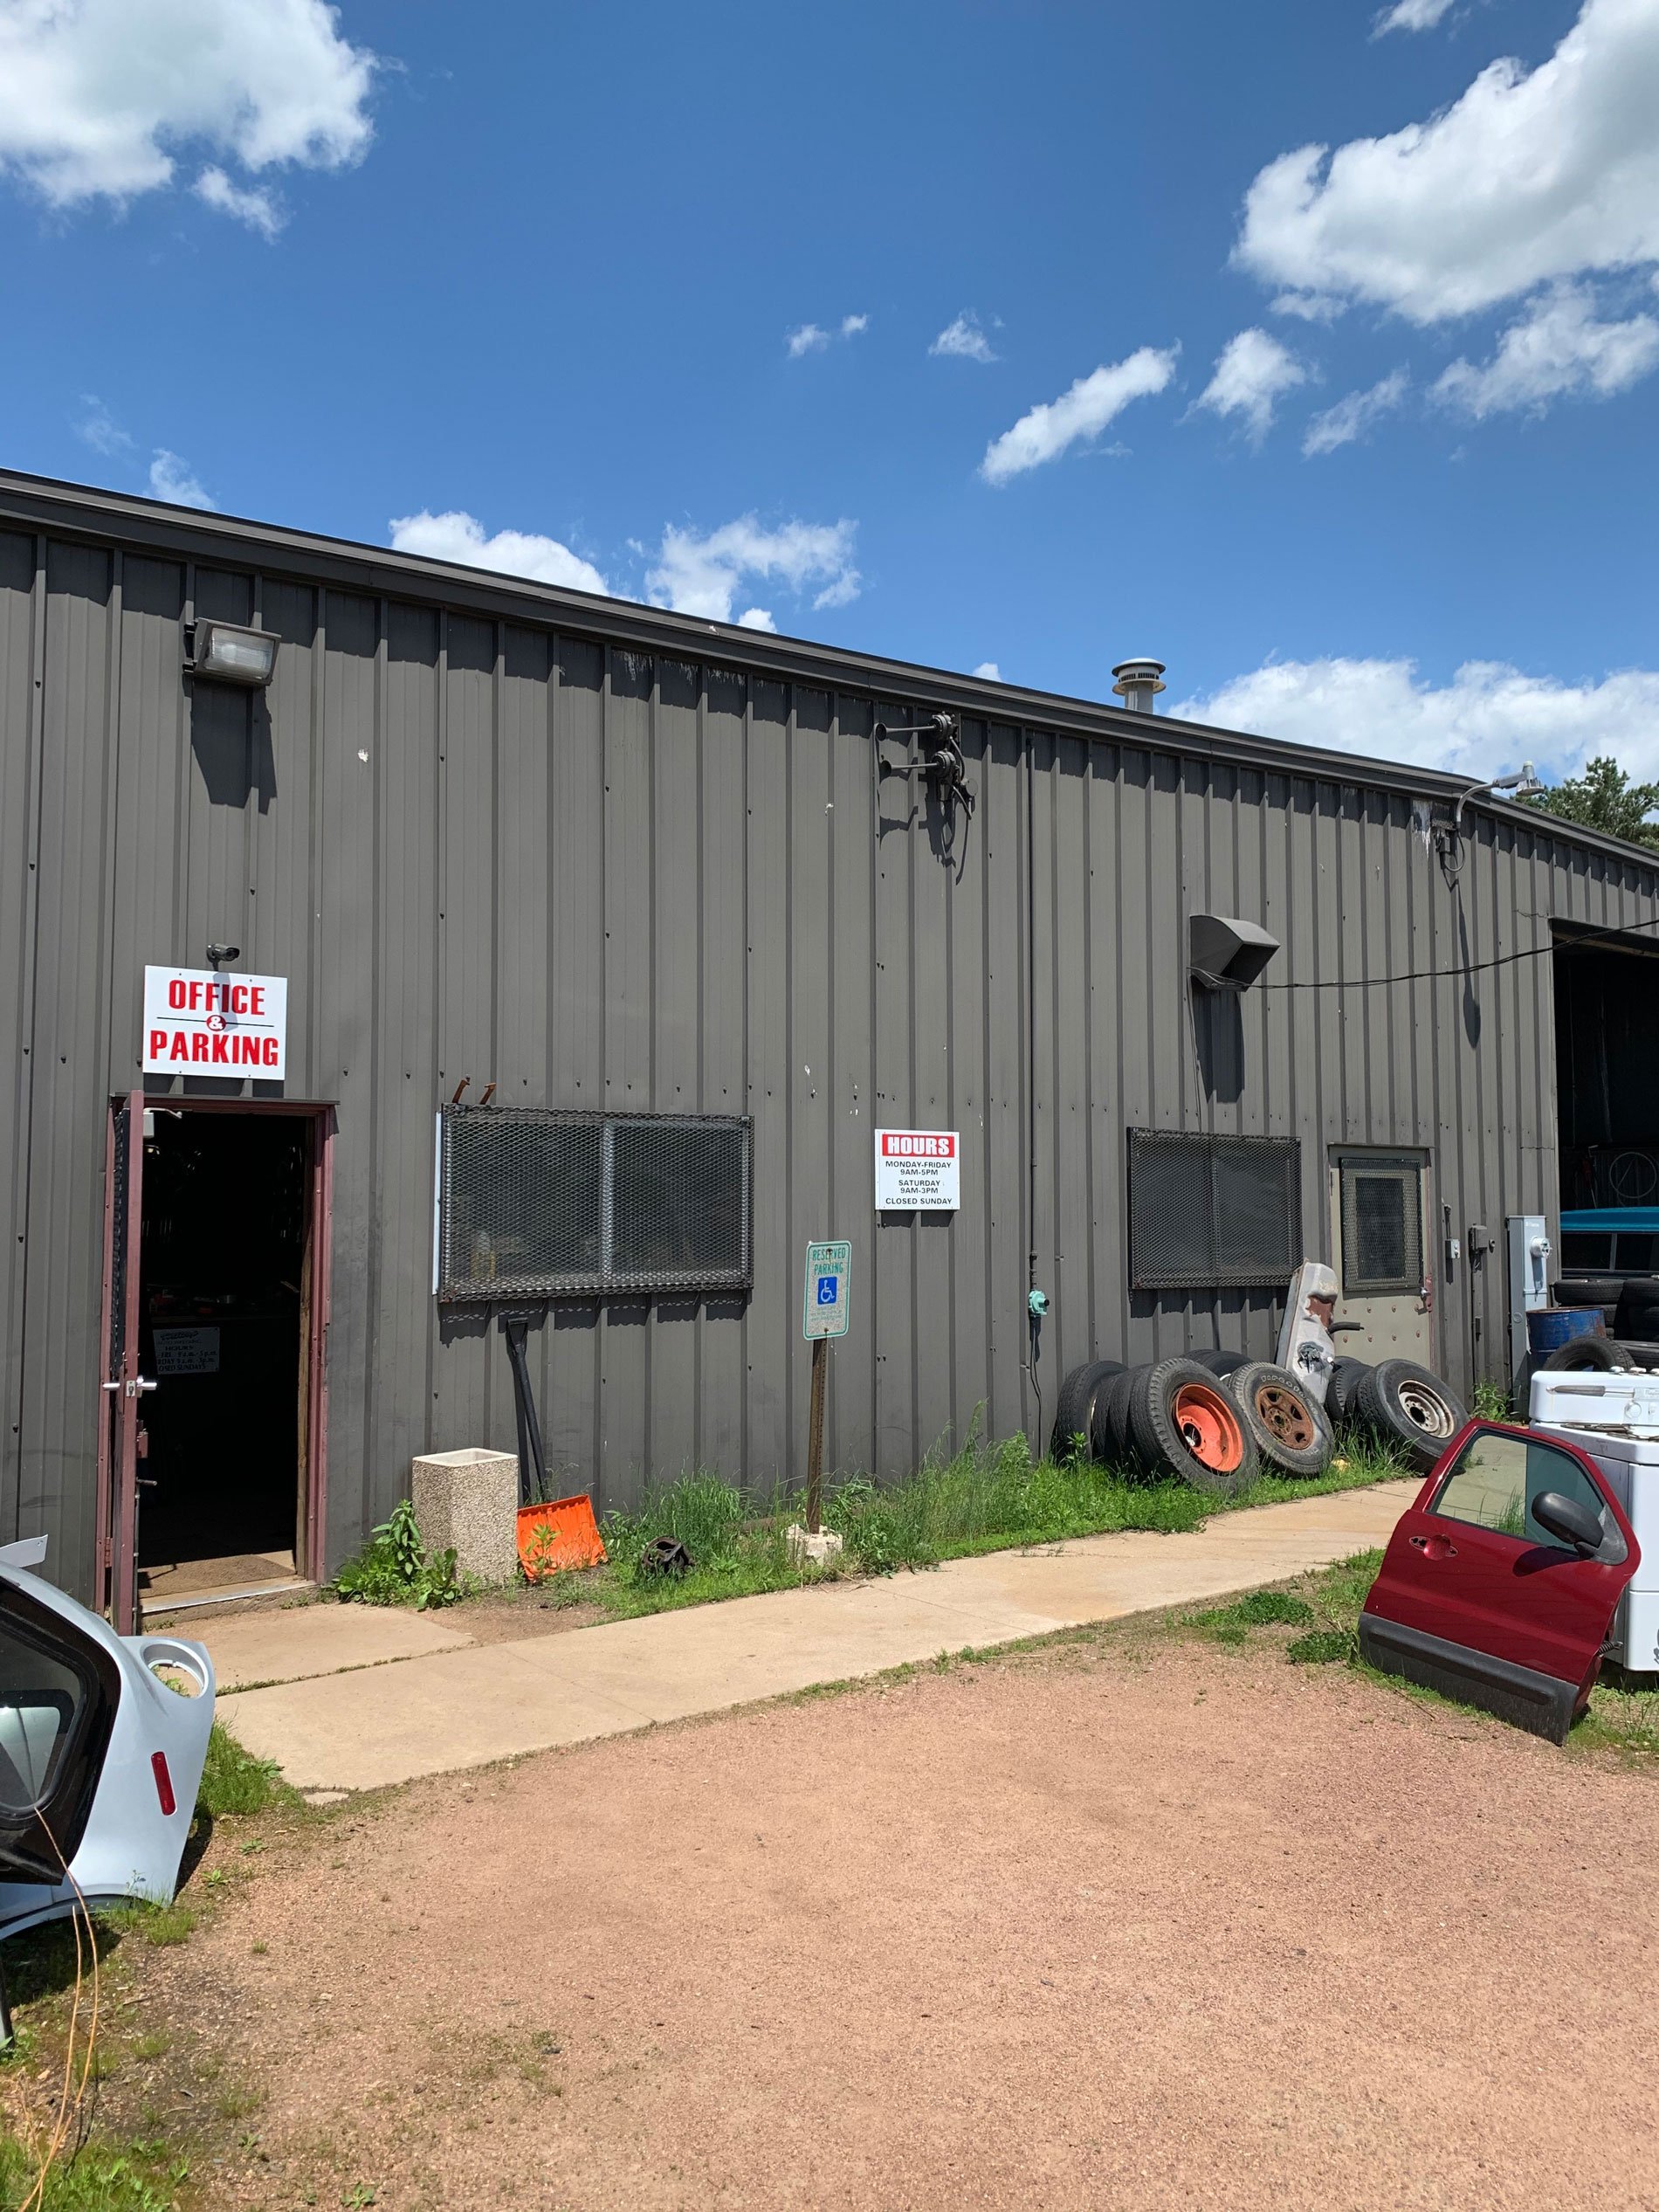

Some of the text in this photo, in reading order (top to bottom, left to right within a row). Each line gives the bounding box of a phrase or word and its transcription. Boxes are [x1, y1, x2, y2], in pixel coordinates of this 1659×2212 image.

[169, 980, 265, 1016] OFFICE
[210, 1016, 224, 1030] &
[149, 1030, 279, 1066] PARKING
[887, 1136, 950, 1155] HOURS
[814, 1262, 843, 1275] PARKING
